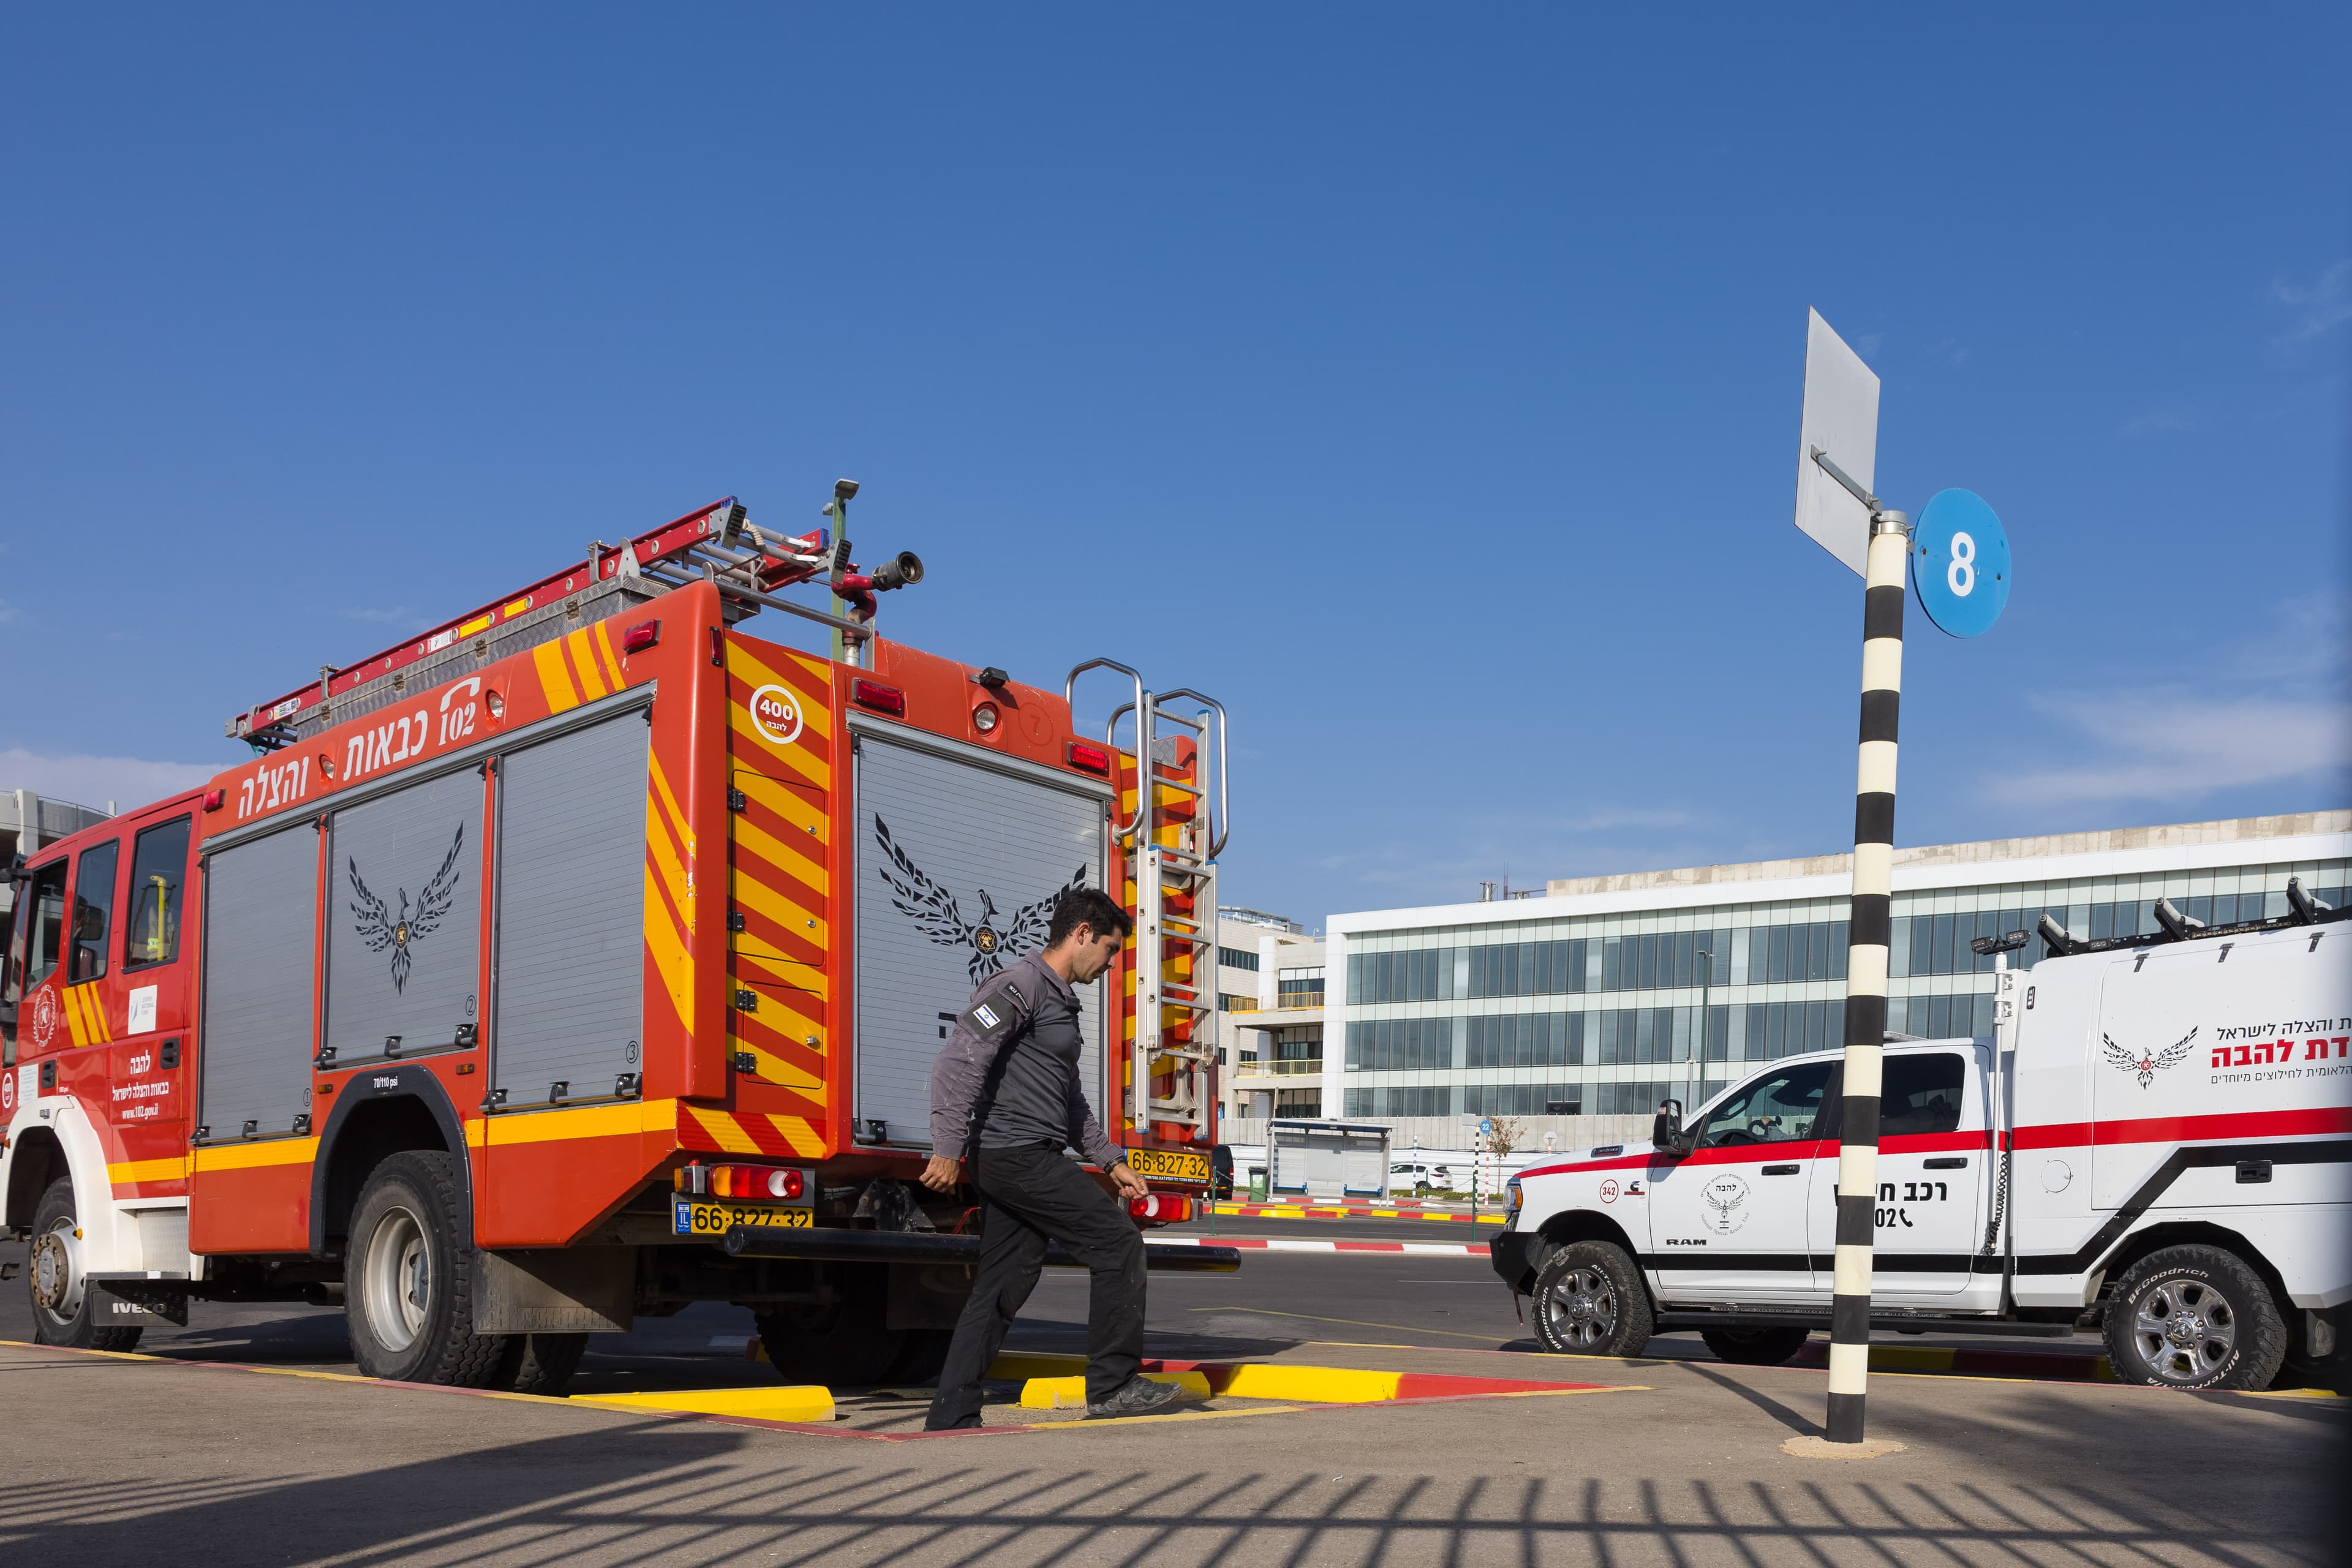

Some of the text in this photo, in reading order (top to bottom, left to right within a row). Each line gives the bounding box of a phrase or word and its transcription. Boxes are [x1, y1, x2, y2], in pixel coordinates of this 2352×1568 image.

[1947, 531, 1976, 597] 8
[760, 699, 793, 721] 400
[766, 720, 787, 731] להבה
[238, 702, 477, 820] 102 כבאות והצלה
[468, 998, 473, 1013] 2
[2217, 1022, 2276, 1041] לישראל
[2282, 1018, 2333, 1035] והצלה
[628, 1044, 636, 1060] 3
[2211, 1039, 2295, 1068] להבה
[130, 1049, 151, 1075] להבה
[373, 1076, 398, 1089] 70/110 psi
[2211, 1073, 2251, 1084] מיוחדים
[2255, 1068, 2302, 1082] לחילוצים
[132, 1082, 150, 1099] והצלה
[151, 1081, 169, 1096] כבאות
[122, 1102, 159, 1120] www.102.gov.il
[1602, 1186, 1616, 1196] 342
[1716, 1183, 1737, 1192] להבה
[1903, 1182, 1947, 1202] רכב
[680, 1212, 689, 1224] IL
[1874, 1208, 1896, 1228] 02
[2127, 1267, 2210, 1305] BFGoodrich
[112, 1303, 167, 1314] IVECO
[1591, 1264, 1618, 1336] All-Terrain T/A
[1540, 1286, 1562, 1349] BFGoodrich
